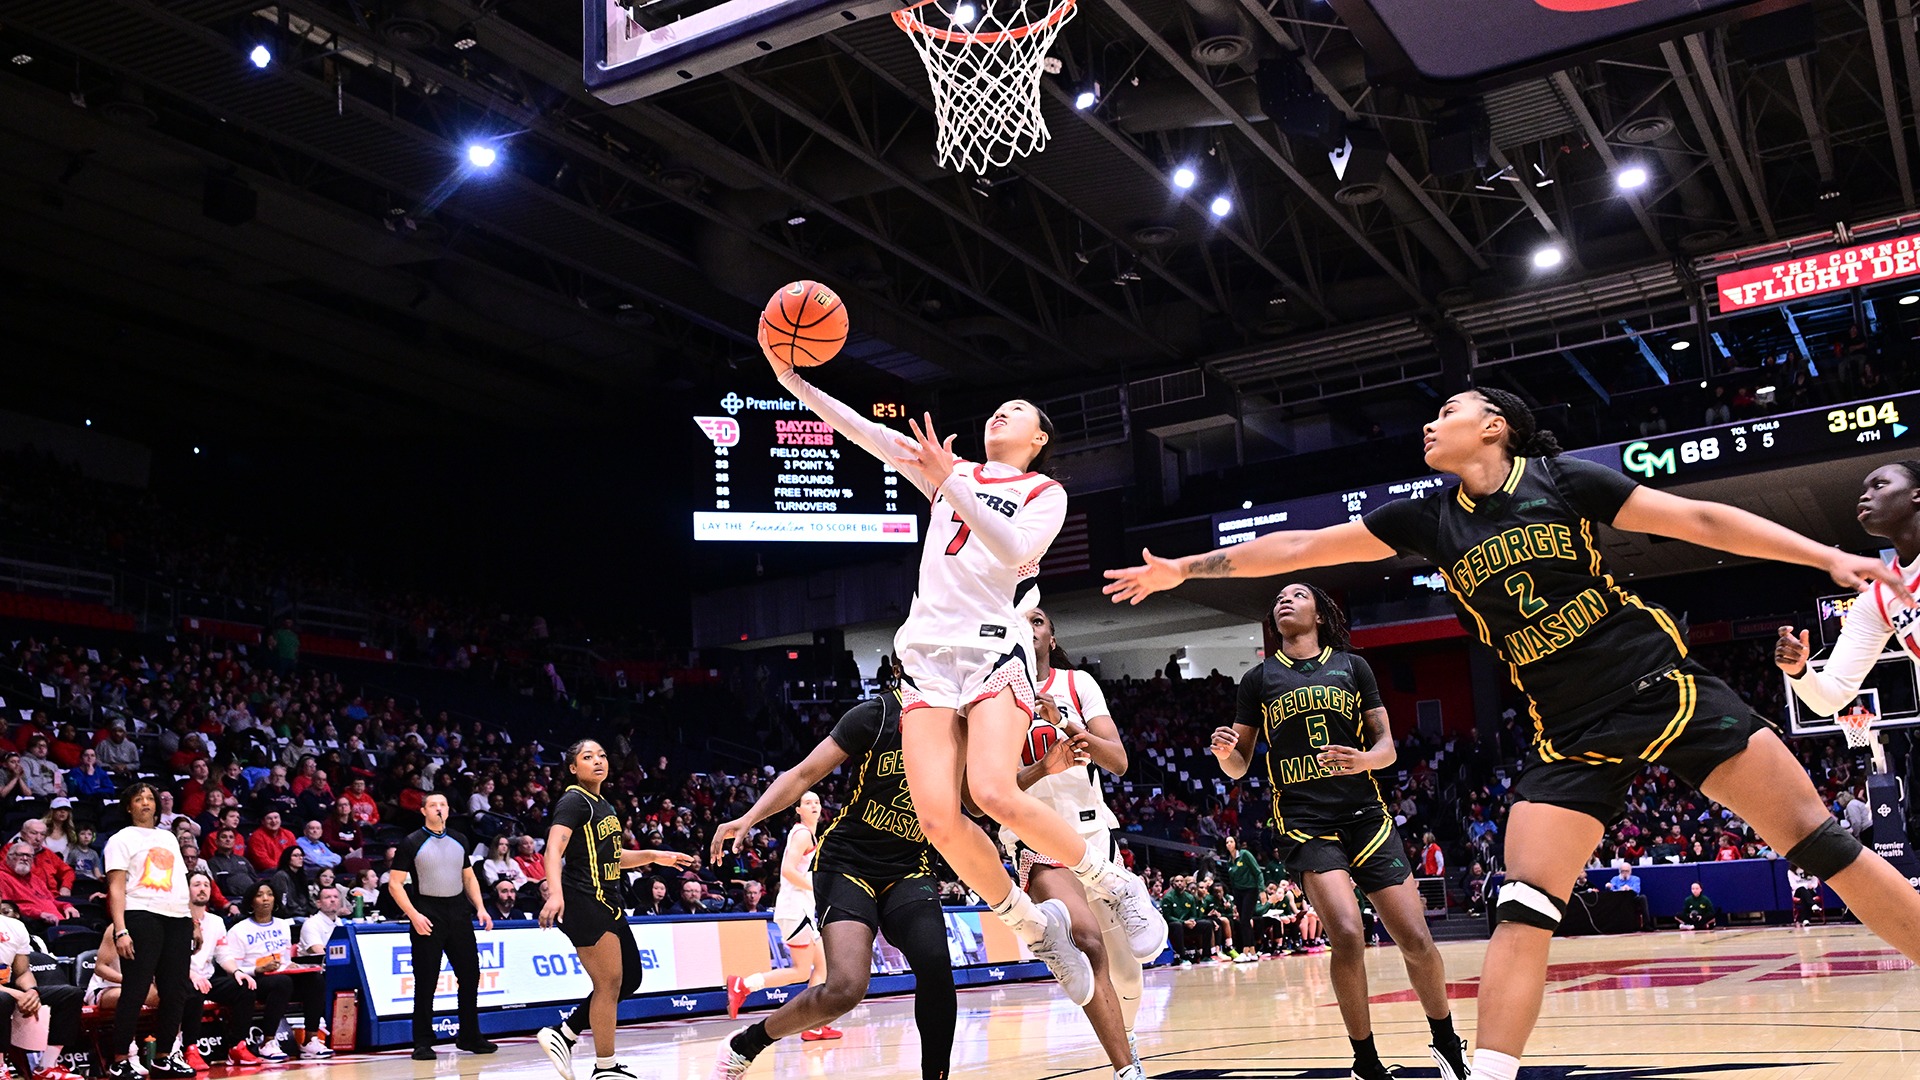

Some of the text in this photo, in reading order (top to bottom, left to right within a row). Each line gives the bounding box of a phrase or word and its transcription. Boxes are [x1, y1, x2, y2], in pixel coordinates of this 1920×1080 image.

[1773, 259, 1817, 279] THE
[1743, 261, 1863, 305] FLIGHT
[746, 397, 796, 411] Premier
[873, 403, 905, 418] 12:51
[1828, 401, 1899, 433] 3:04
[775, 420, 834, 434] DAYTON
[1731, 420, 1780, 436] TOL FOULS
[777, 433, 834, 446] FLYERS
[1857, 430, 1880, 444] 4TH
[770, 448, 799, 457] FIELD
[801, 448, 829, 458] GOAL
[830, 449, 840, 458] %
[1680, 437, 1719, 464] 68
[1735, 437, 1747, 452] 3
[1763, 433, 1774, 448] 5
[784, 460, 791, 469] 3
[793, 460, 823, 470] POINT
[825, 461, 834, 470] %
[778, 474, 834, 484] REBOUNDS
[774, 488, 801, 497] FREE
[803, 488, 840, 498] THROW
[842, 489, 853, 498] %
[775, 501, 837, 511] TURNOVERS
[886, 503, 897, 511] 11
[702, 522, 721, 530] LAY
[725, 522, 742, 530] THE
[810, 523, 823, 531] TO
[826, 523, 857, 531] SCORE
[861, 523, 878, 532] BIG
[1452, 523, 1577, 598] GEORGE
[1504, 570, 1549, 619] 2
[1504, 588, 1609, 667] MASON
[1269, 685, 1355, 729] GEORGE
[1305, 714, 1330, 749] 5
[1021, 725, 1057, 767] 10
[862, 799, 926, 843] MASO
[1874, 842, 1904, 851] Premier
[1877, 849, 1904, 858] Health
[247, 929, 282, 945] DAYTON
[29, 962, 57, 973] Source
[532, 954, 568, 977] GO
